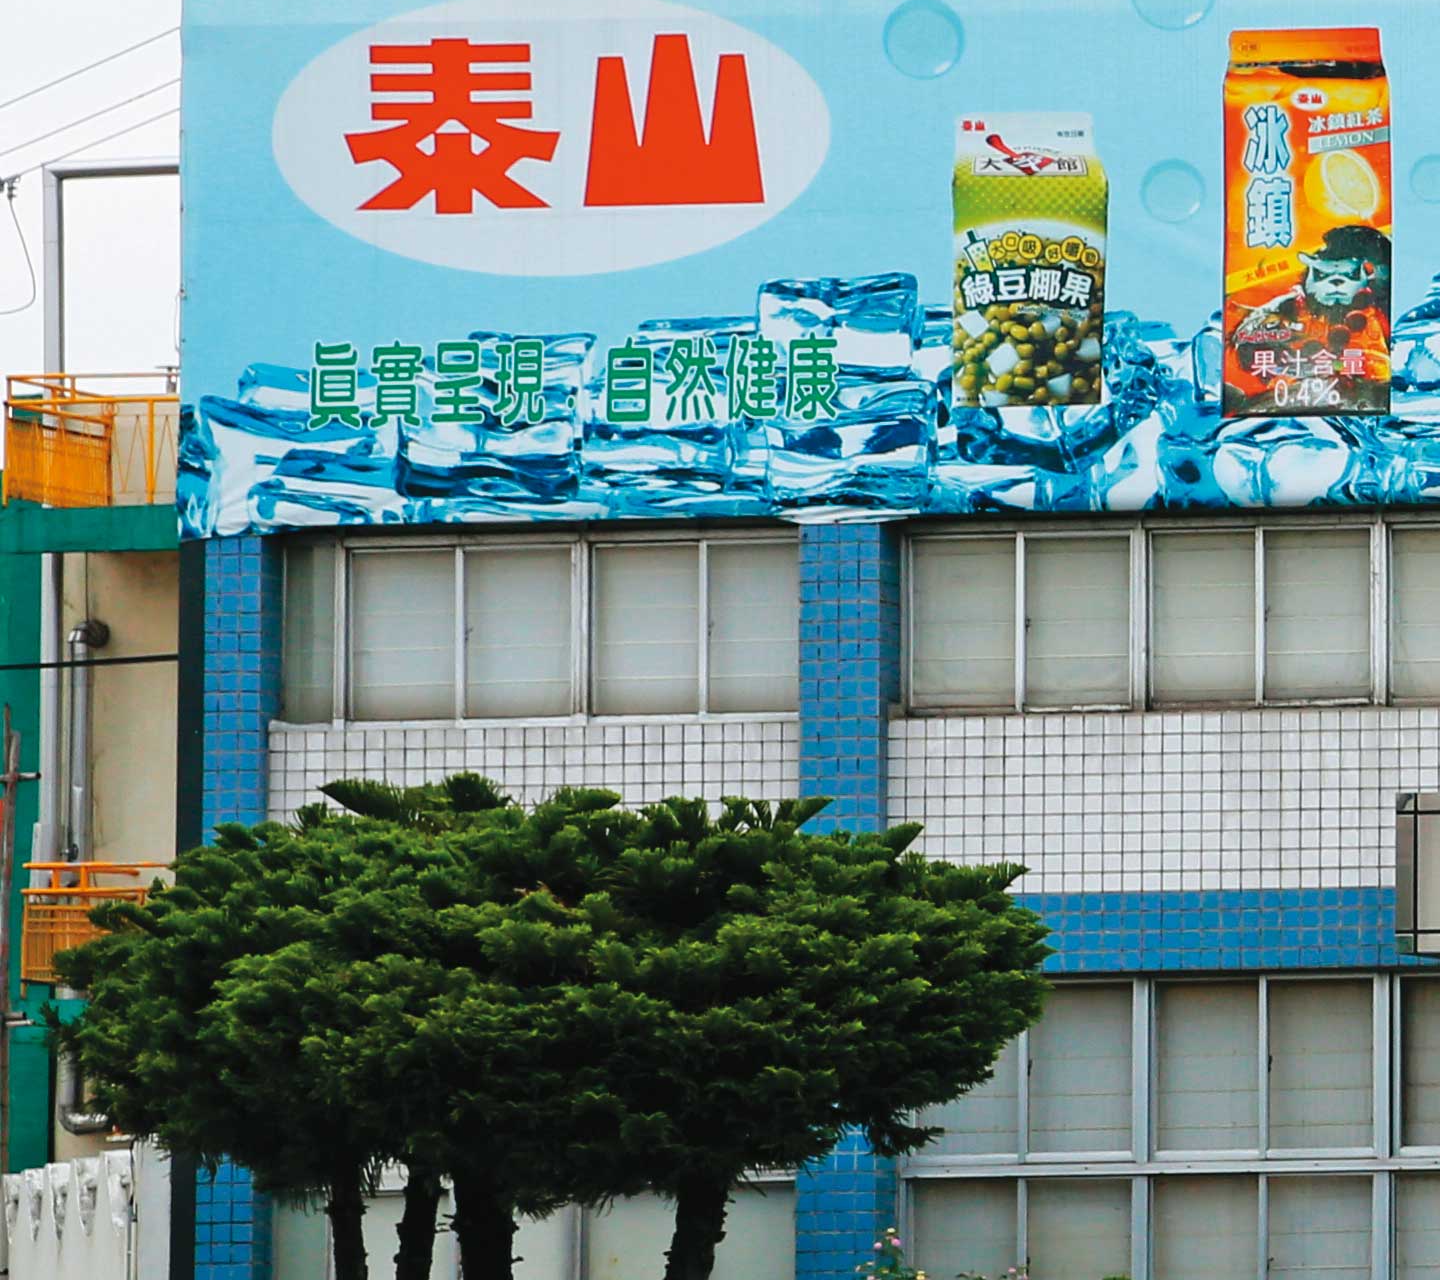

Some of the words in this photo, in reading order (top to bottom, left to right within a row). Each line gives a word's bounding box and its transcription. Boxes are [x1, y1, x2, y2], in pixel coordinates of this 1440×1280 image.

[343, 33, 765, 214] 泰山
[1308, 108, 1383, 133] 冰鎮紅茶
[1319, 131, 1375, 148] LEMON
[1243, 104, 1293, 249] 冰鎮
[962, 268, 1093, 307] 綠豆椰果
[1251, 349, 1365, 377] 果汁含量
[1274, 377, 1341, 406] 0.4%
